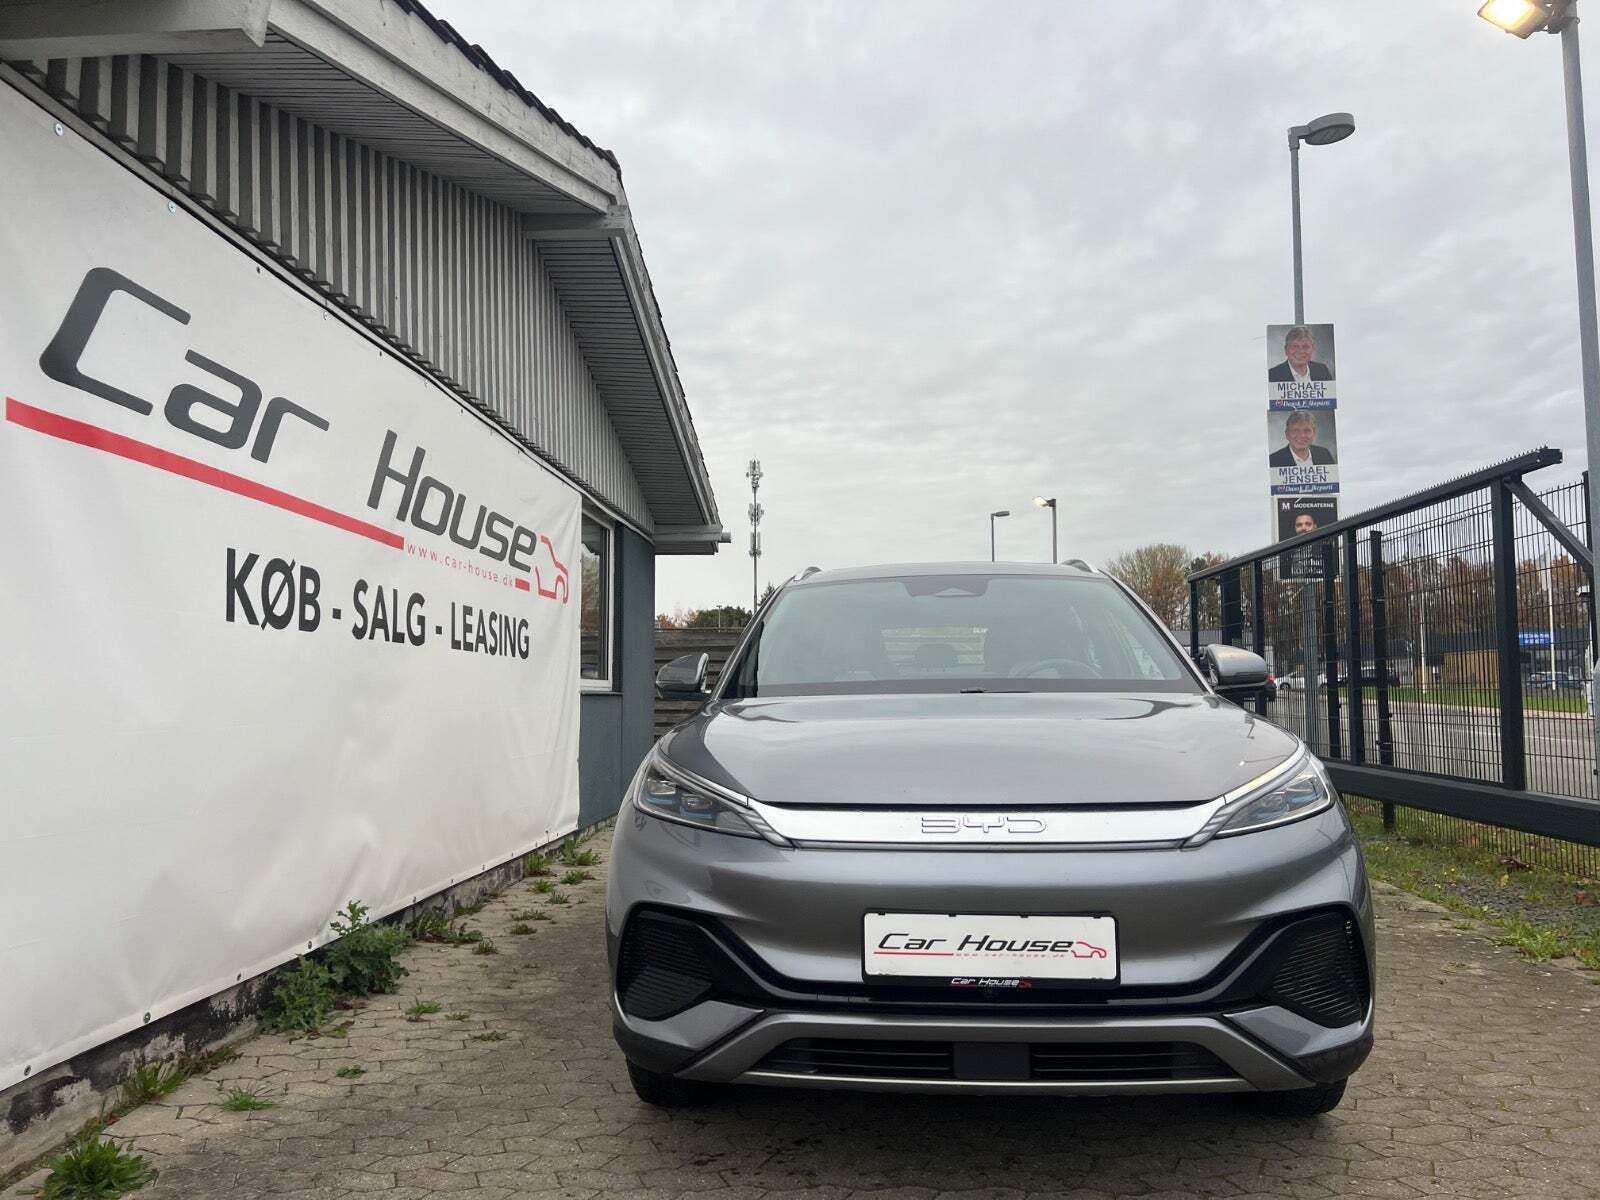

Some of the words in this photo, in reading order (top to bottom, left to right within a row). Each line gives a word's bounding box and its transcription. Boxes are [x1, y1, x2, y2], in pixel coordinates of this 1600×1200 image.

[1277, 382, 1327, 391] MICHAEL
[1280, 390, 1324, 399] JENSEN
[39, 266, 330, 464] Car
[366, 429, 537, 574] House
[1279, 466, 1329, 476] MICHAEL
[1282, 475, 1327, 484] JENSEN
[1282, 502, 1290, 510] M
[407, 543, 514, 588] www.car-house.dk
[225, 547, 321, 632] KØB
[351, 579, 426, 646] SALG
[451, 601, 530, 660] LEASING
[921, 815, 1047, 834] BYD
[878, 933, 947, 950] Car
[957, 934, 1075, 952] House
[951, 977, 976, 985] Car
[978, 978, 1020, 986] House
